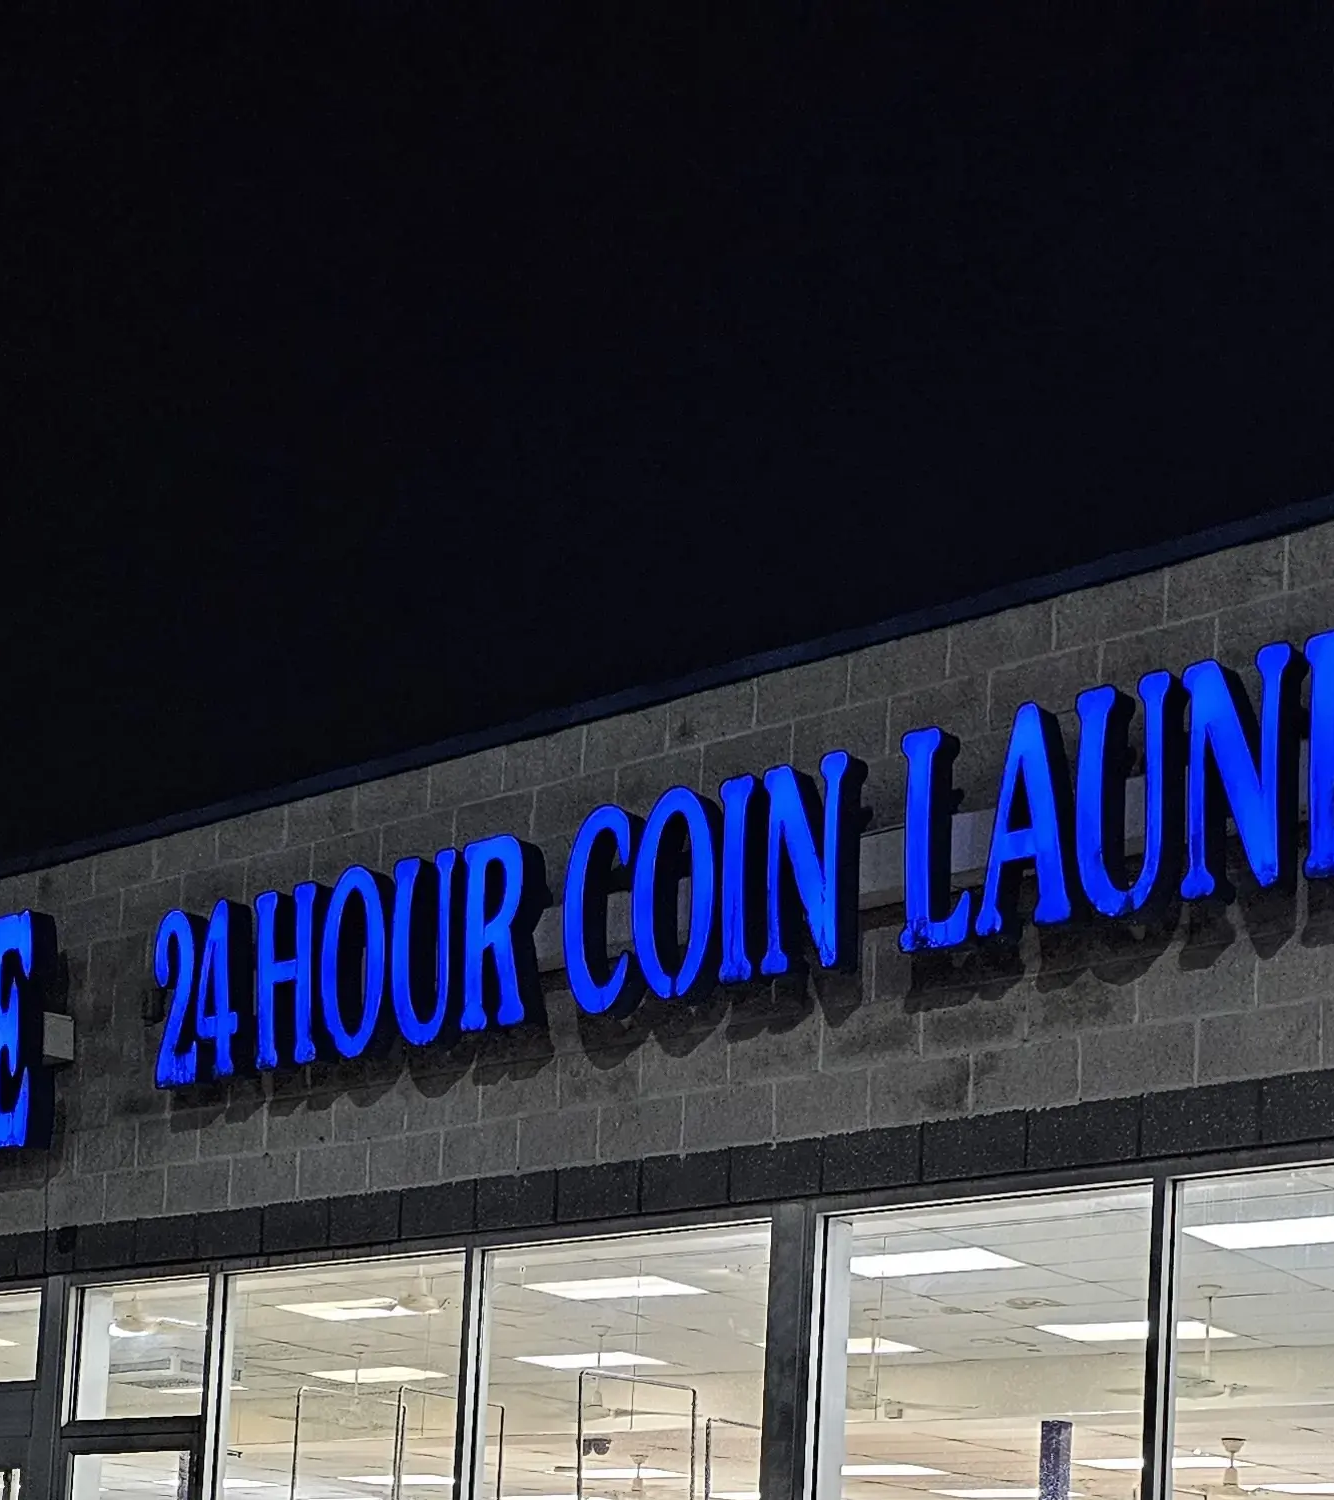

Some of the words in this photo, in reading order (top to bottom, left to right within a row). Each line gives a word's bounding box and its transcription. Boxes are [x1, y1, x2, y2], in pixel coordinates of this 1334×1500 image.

[154, 900, 239, 1089] 24
[254, 832, 526, 1070] HOUR
[561, 750, 850, 1015] COIN
